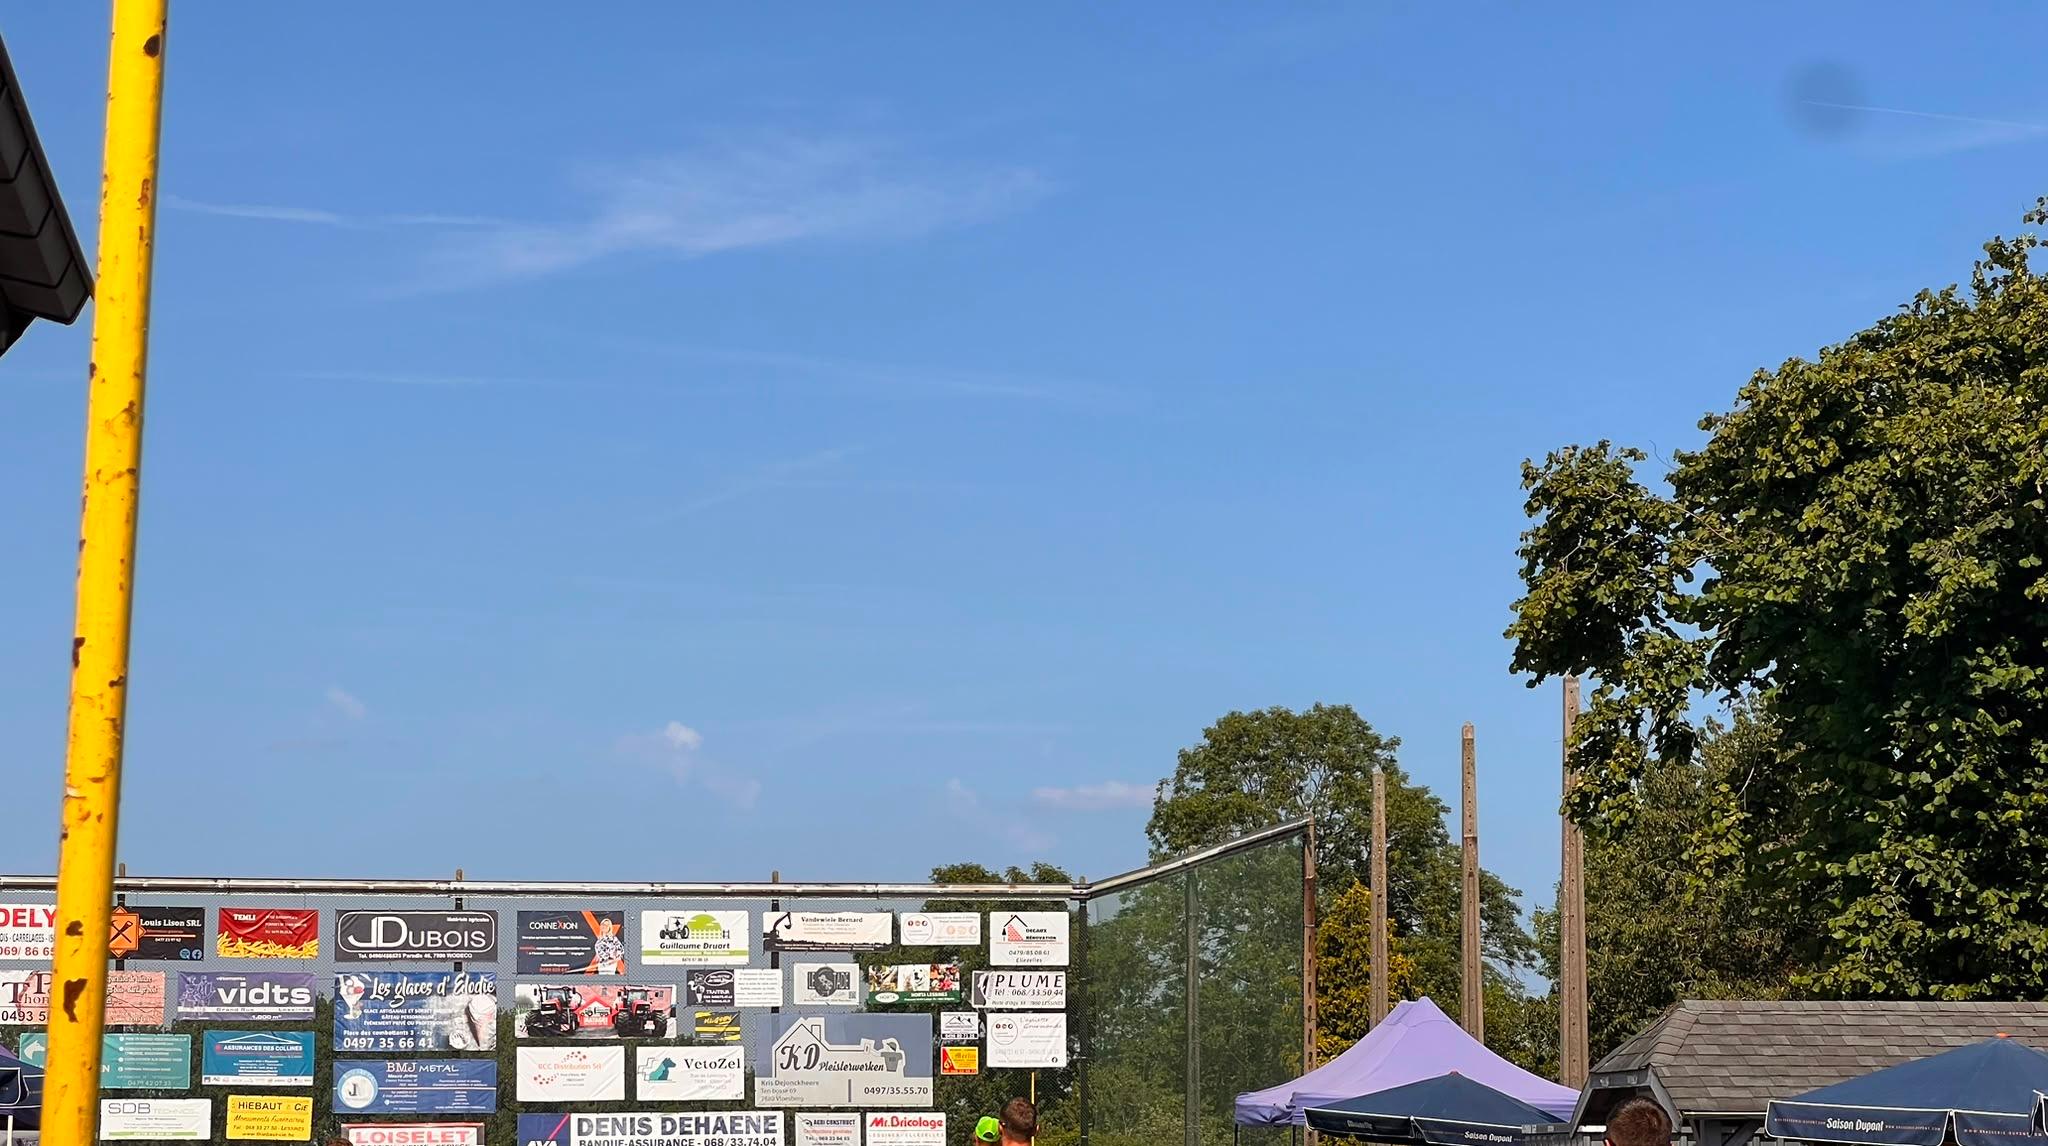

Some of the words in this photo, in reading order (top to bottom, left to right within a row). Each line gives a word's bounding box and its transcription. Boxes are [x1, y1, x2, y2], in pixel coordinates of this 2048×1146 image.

[529, 920, 578, 930] CONNEXION
[24, 946, 39, 956] 86
[996, 975, 1064, 988] PLUME
[216, 982, 311, 1004] vidts
[370, 976, 390, 1000] Les
[389, 976, 433, 1008] glaces
[453, 971, 496, 995] Élodie
[2, 1010, 34, 1022] 0493
[343, 1038, 374, 1048] 0497
[380, 1038, 394, 1048] 35
[399, 1038, 414, 1048] 66
[418, 1038, 434, 1048] 41
[386, 1062, 417, 1072] BMJ
[418, 1064, 459, 1072] METAL
[684, 1058, 740, 1069] VetoZel
[818, 1060, 884, 1072] Pleisterwerken
[864, 1086, 928, 1095] 0497/35.55.70
[108, 1103, 150, 1114] SDB
[577, 1116, 654, 1136] DENIS
[661, 1116, 778, 1135] DEHAENE
[1826, 1117, 1854, 1130] Saison
[1855, 1118, 1884, 1132] Dupont
[356, 1131, 470, 1143] LOISELET
[579, 1138, 695, 1146] BANQUE-ASSURANCE
[704, 1138, 777, 1146] 068/33.74.04
[1464, 1130, 1487, 1141] Saison
[1489, 1132, 1513, 1143] Dupont
